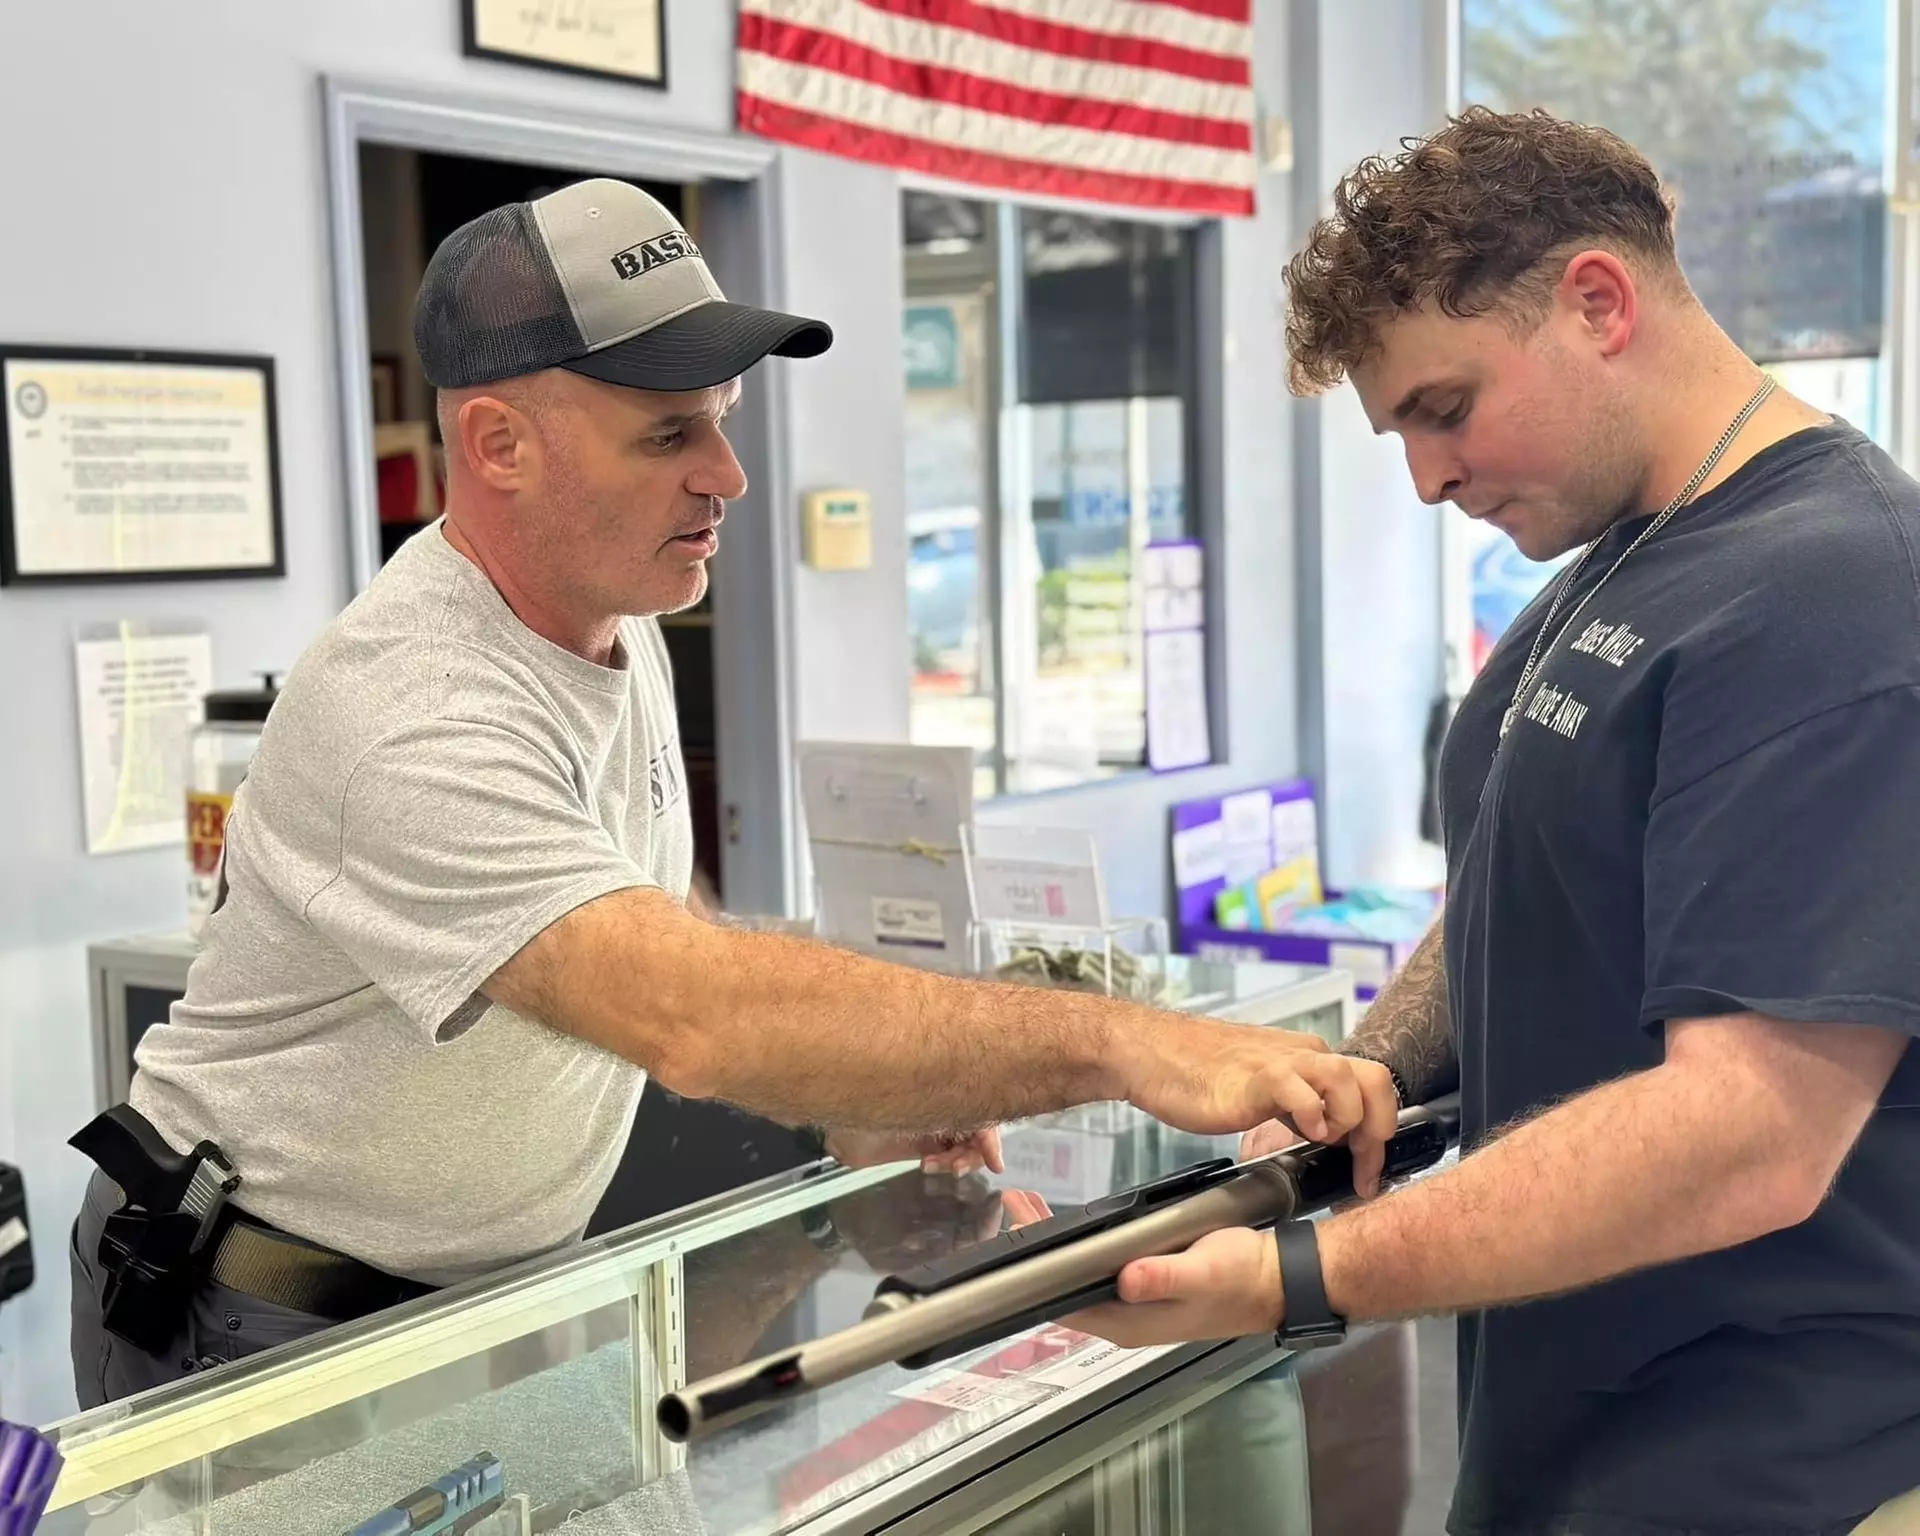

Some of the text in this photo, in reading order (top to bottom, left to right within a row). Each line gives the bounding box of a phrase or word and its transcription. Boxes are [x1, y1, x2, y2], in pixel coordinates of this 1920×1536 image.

[611, 232, 700, 280] BAS
[1595, 623, 1645, 667] WHILE
[1548, 691, 1589, 740] AWAY
